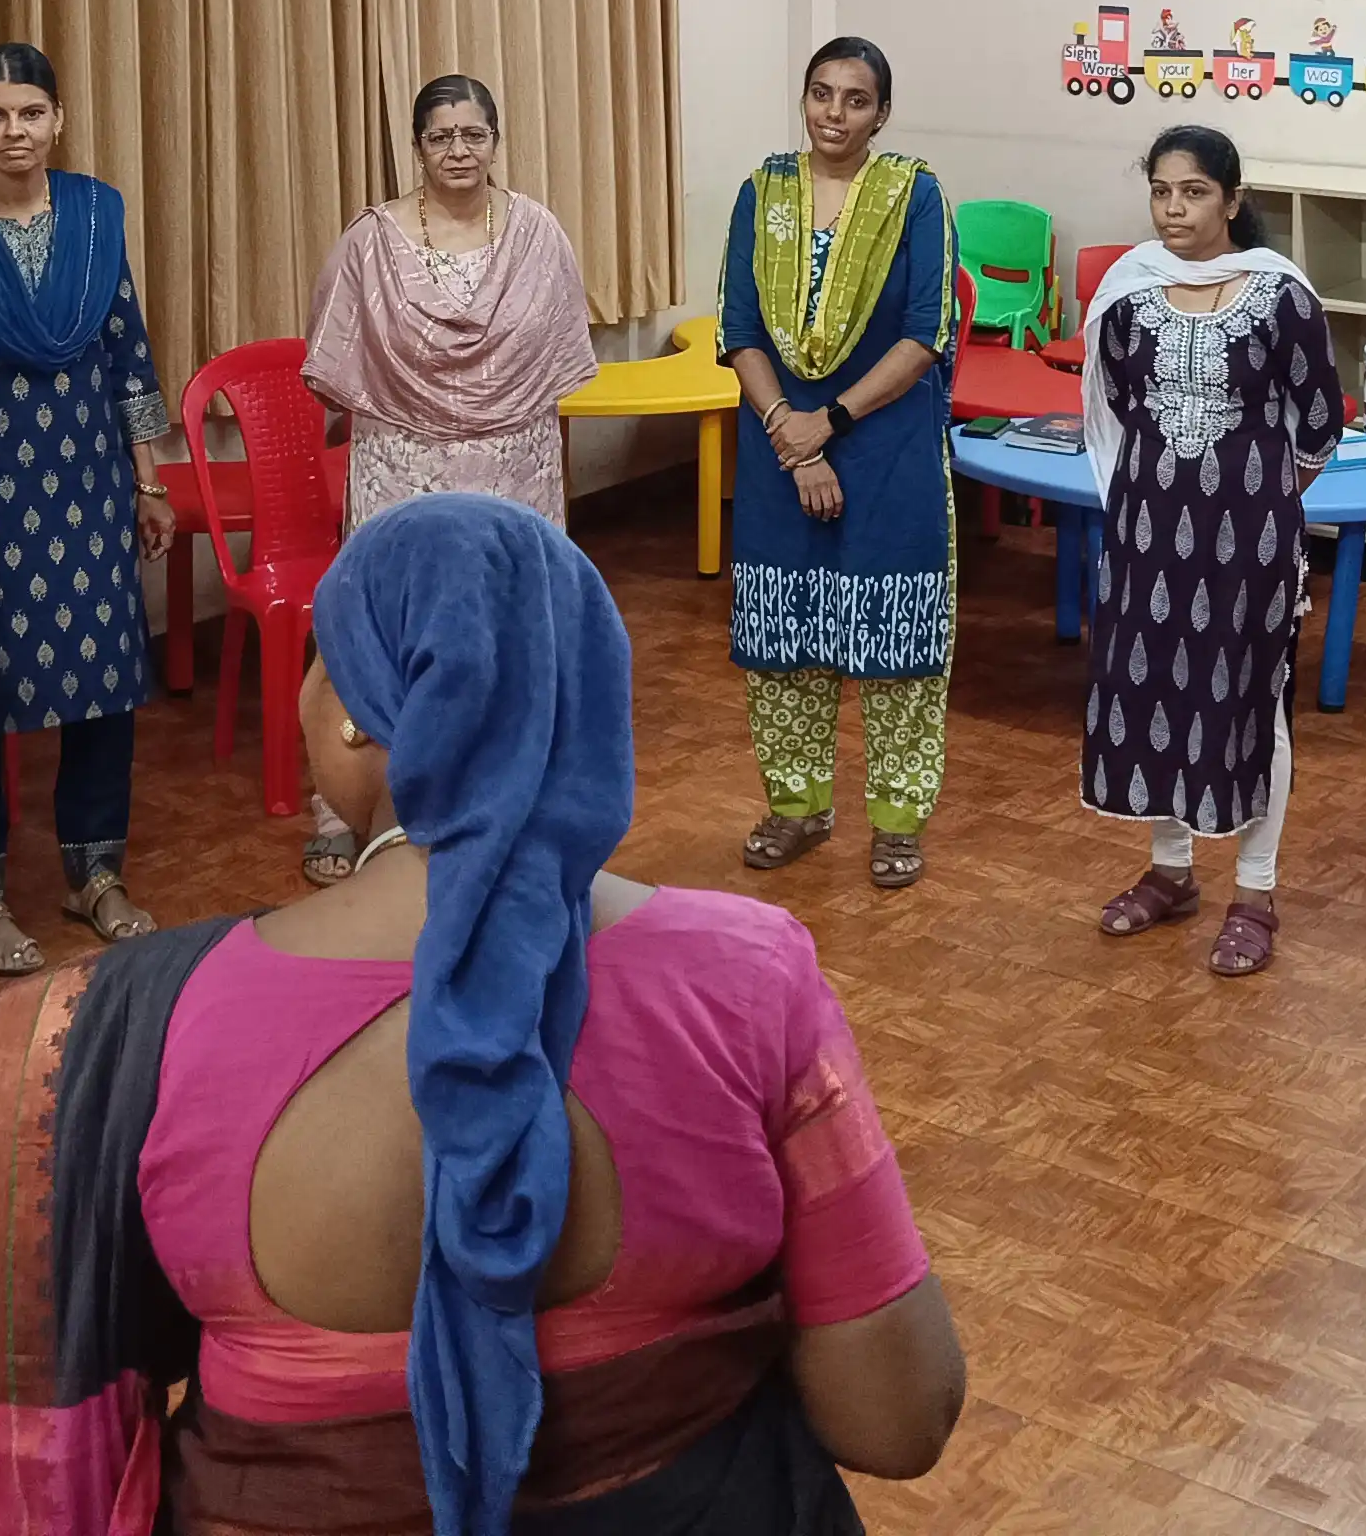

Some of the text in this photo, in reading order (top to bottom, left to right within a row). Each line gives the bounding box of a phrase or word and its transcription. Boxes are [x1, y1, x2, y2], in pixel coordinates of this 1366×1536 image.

[1063, 44, 1099, 62] Sight
[1081, 61, 1126, 79] Words
[1158, 63, 1191, 79] your
[1229, 62, 1256, 80] her
[1305, 68, 1340, 83] was
